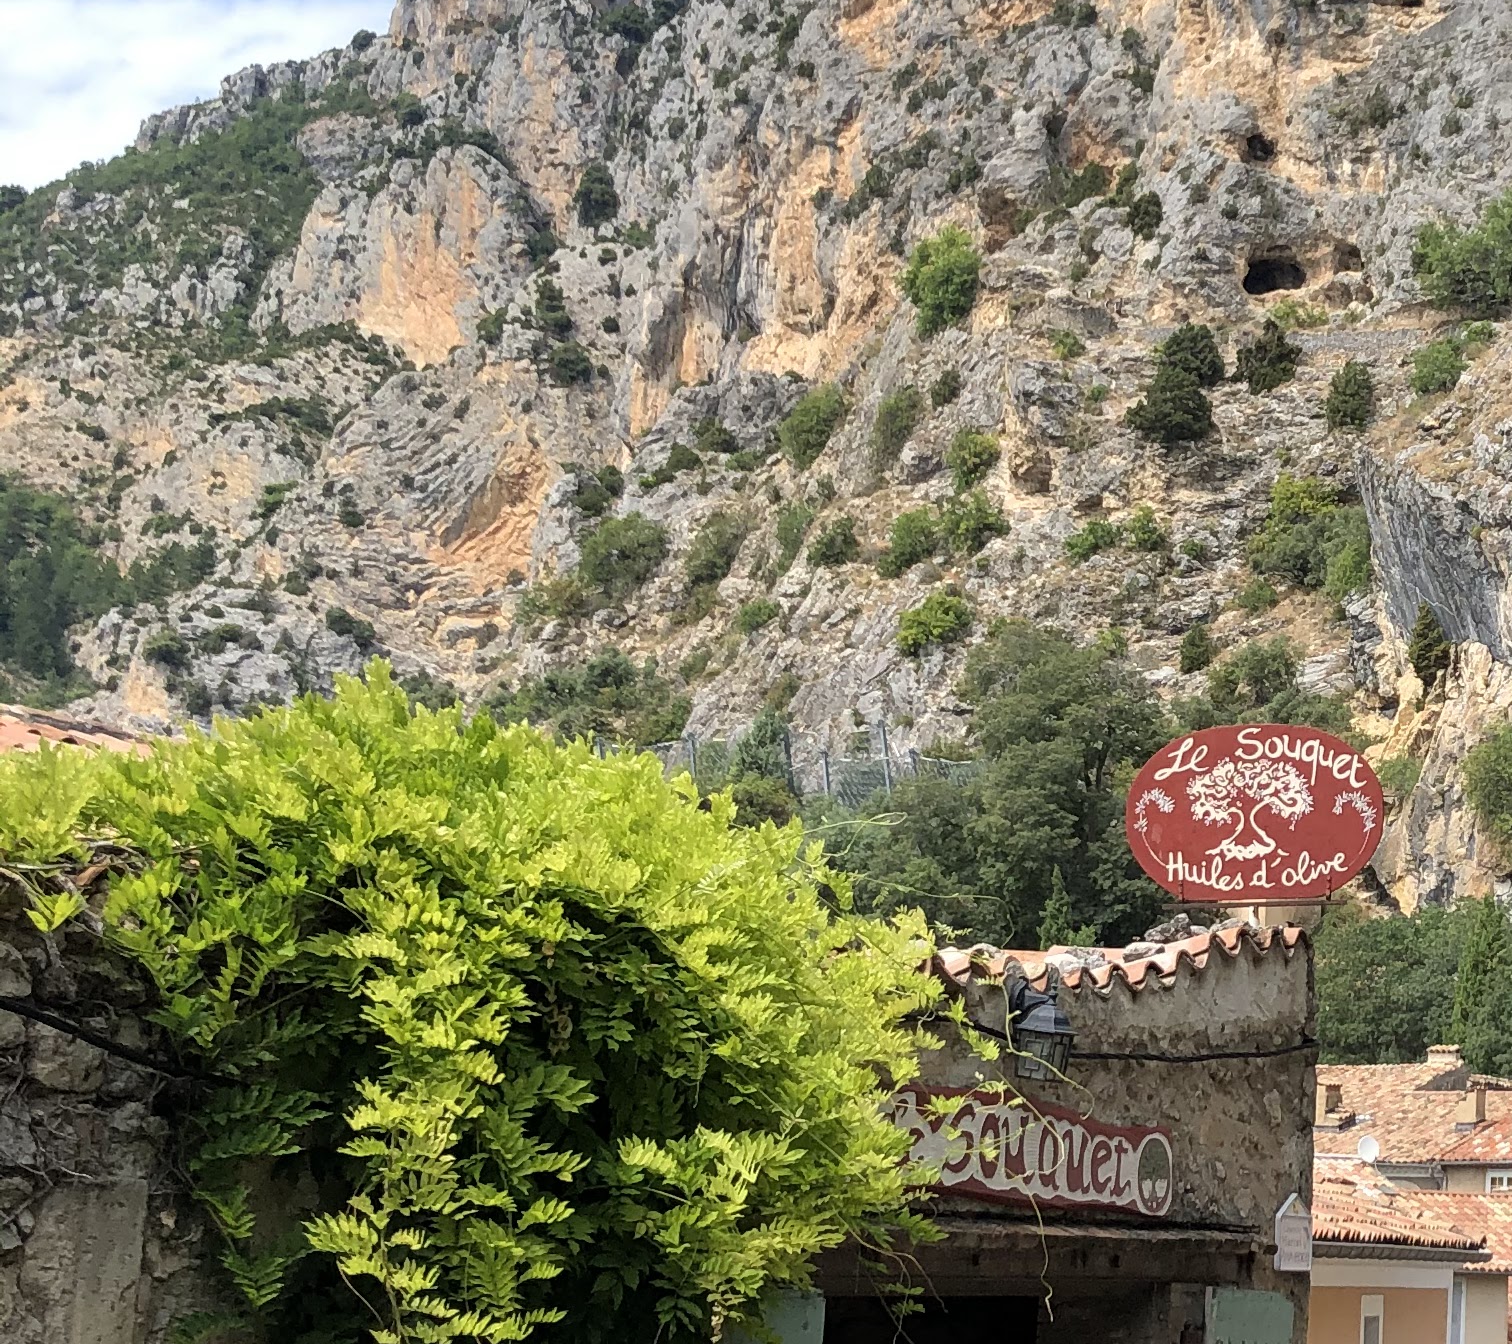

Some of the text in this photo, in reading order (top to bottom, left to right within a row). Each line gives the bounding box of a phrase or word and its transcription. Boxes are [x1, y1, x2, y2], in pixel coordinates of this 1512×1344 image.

[1154, 727, 1367, 787] Le Souquet
[1165, 851, 1245, 891] Huiles
